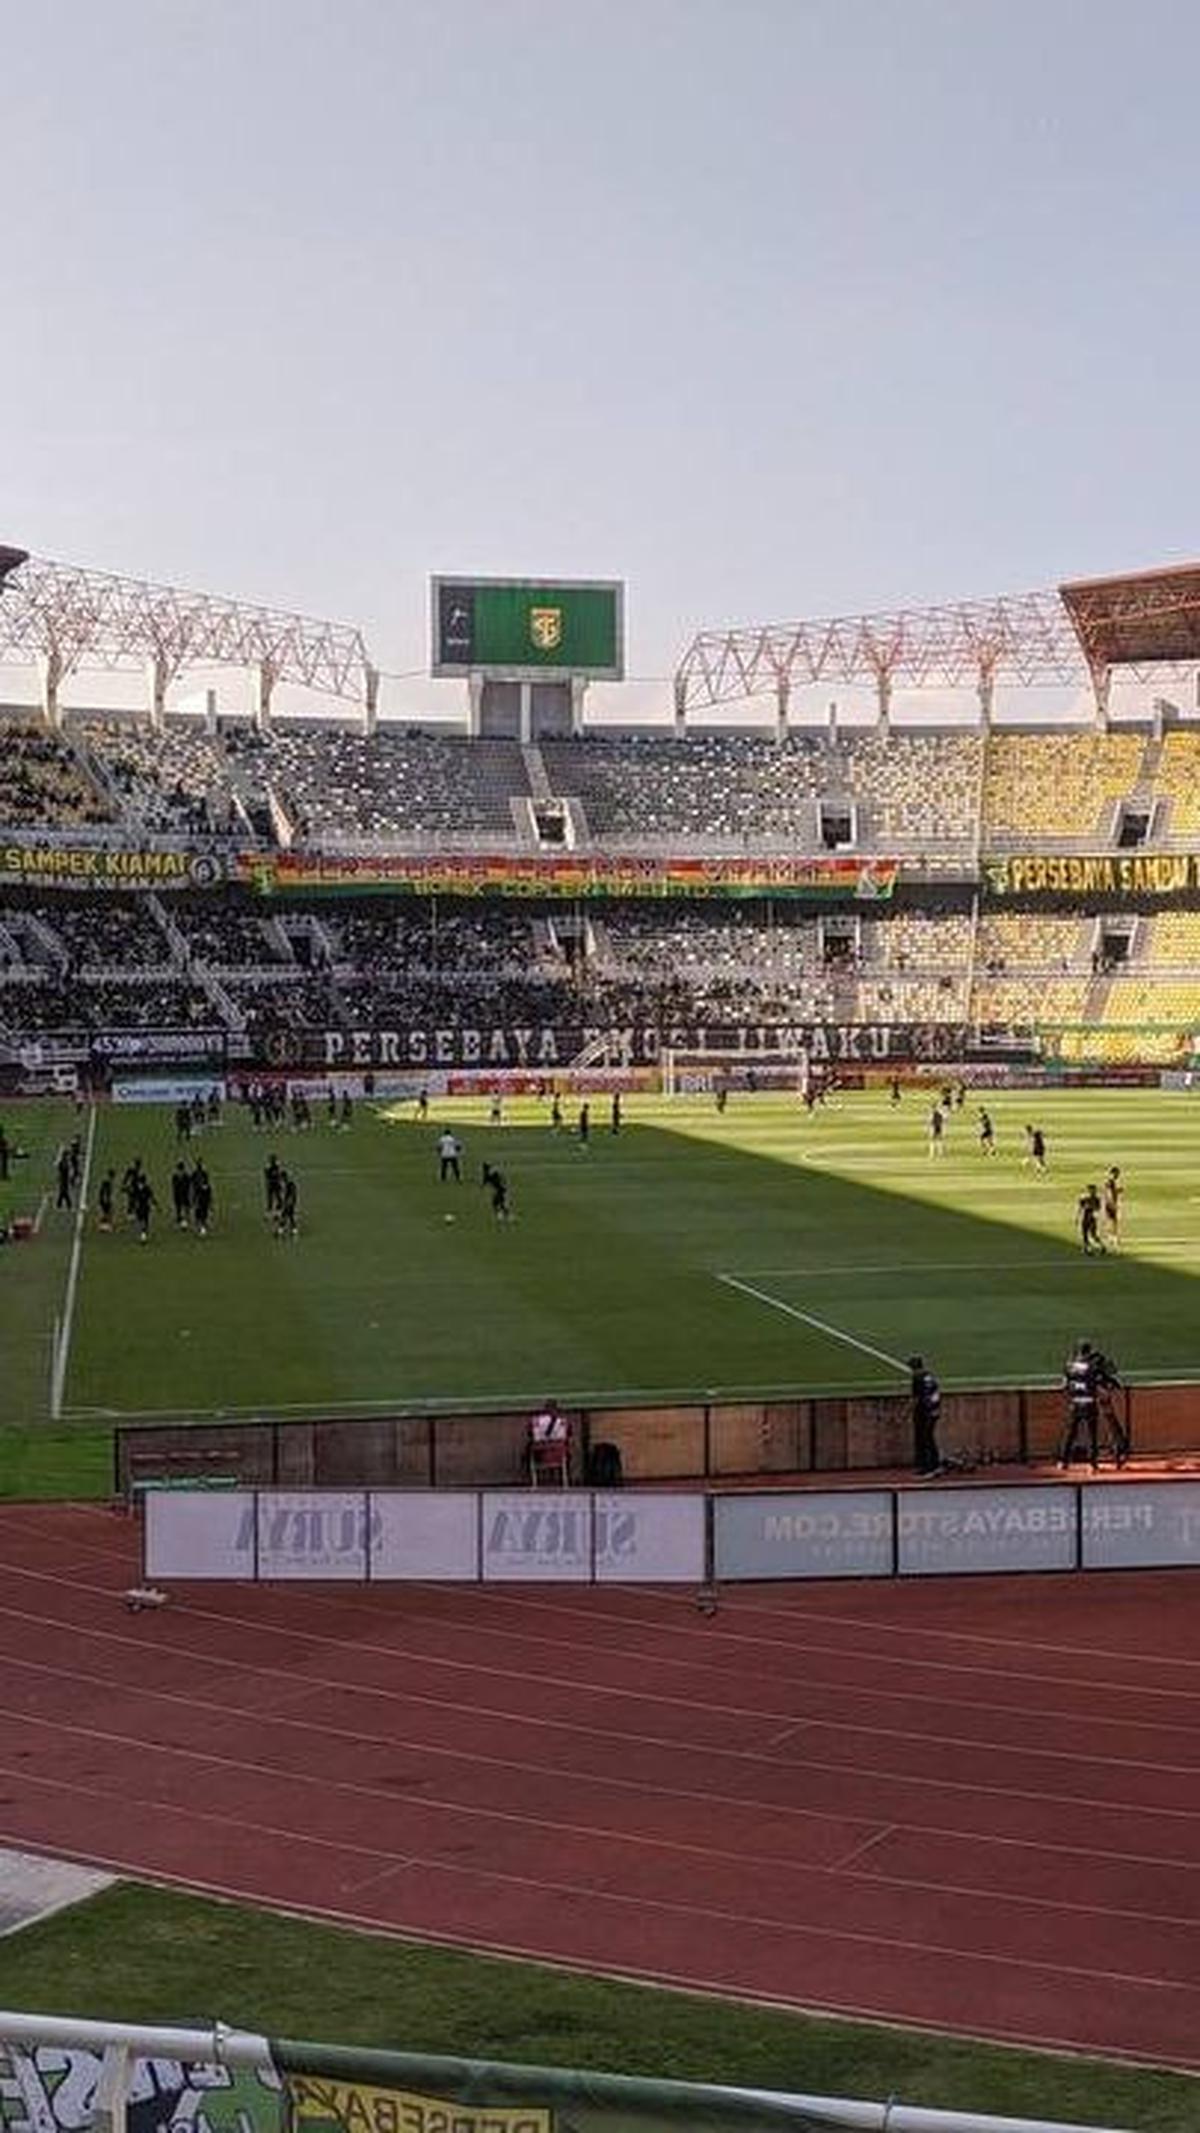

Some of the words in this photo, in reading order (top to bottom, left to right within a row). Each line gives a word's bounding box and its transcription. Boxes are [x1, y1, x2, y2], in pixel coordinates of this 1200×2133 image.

[5, 850, 98, 875] SAMPEK
[105, 853, 189, 876] KIAMAT
[1012, 858, 1115, 891] PERSEBAYA
[325, 1030, 559, 1064] PERSEBAYA
